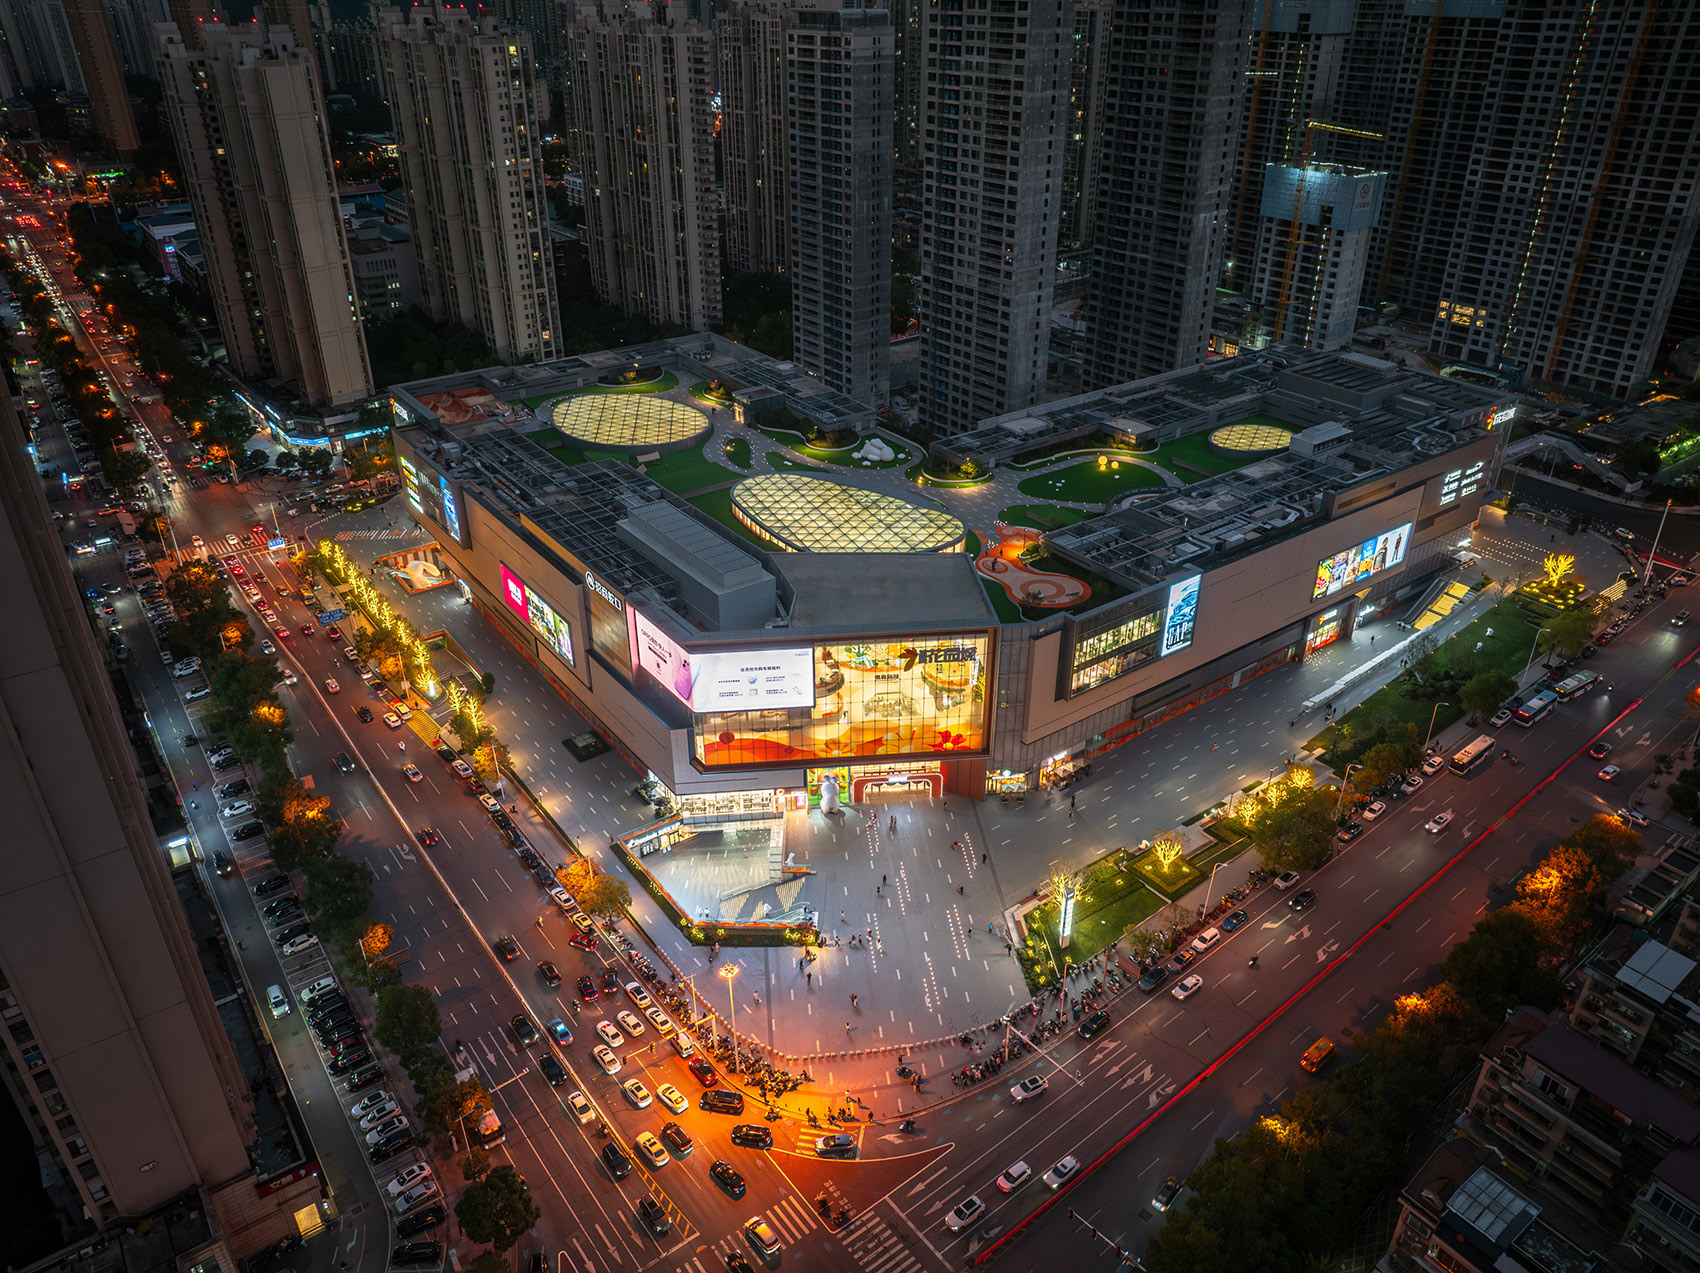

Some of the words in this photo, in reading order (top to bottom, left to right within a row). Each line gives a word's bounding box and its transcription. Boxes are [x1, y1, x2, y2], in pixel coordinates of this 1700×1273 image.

[594, 580, 622, 611] 招商蛇口
[1168, 622, 1188, 646] GAP
